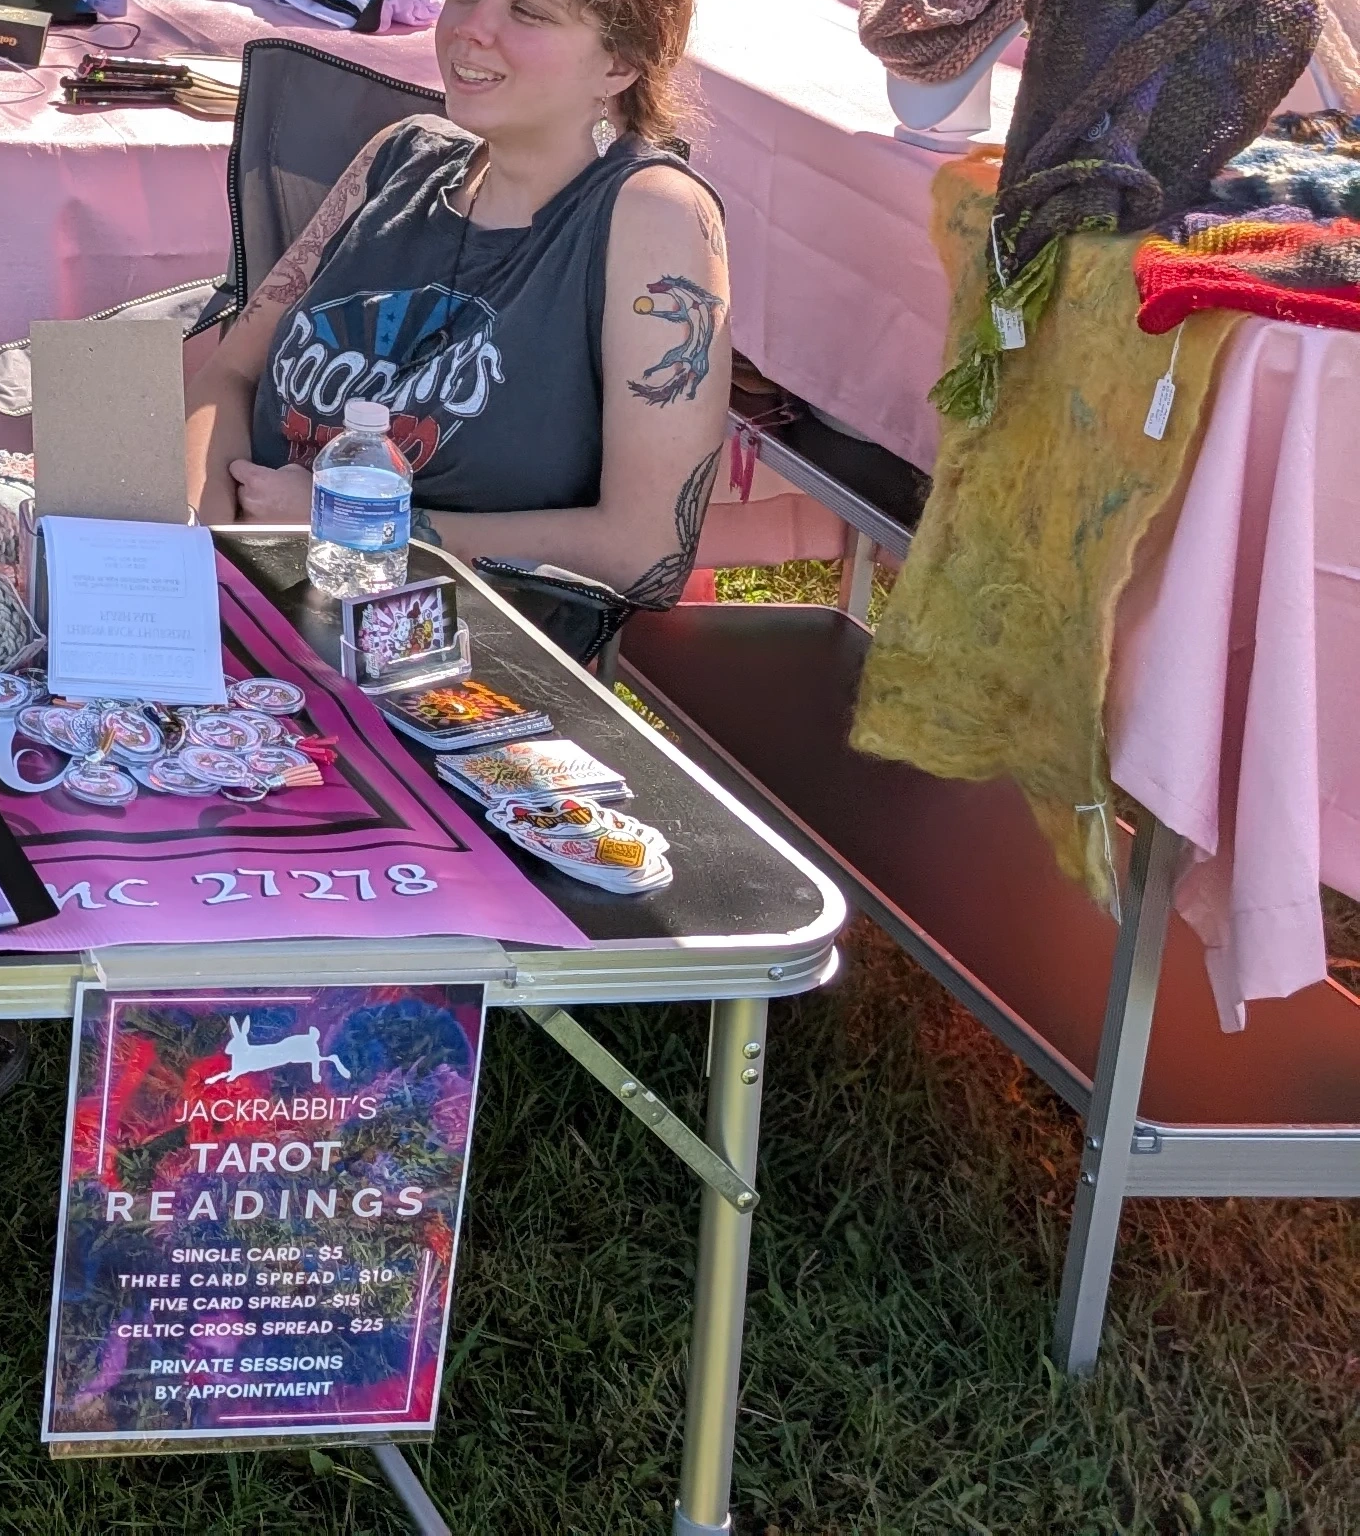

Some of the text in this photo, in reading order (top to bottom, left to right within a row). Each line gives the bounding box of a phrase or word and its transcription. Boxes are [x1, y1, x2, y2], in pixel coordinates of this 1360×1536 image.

[192, 863, 439, 906] 27278
[175, 1096, 378, 1123] JACKRABBIT'S
[190, 1141, 343, 1174] TAROT
[105, 1186, 425, 1222] READINGS
[171, 1248, 241, 1263] SINGLE
[246, 1247, 301, 1262] CARD
[318, 1245, 343, 1261] $5
[118, 1274, 181, 1288] THREE
[189, 1273, 247, 1287] CARD
[255, 1271, 335, 1286] SPREAD
[358, 1268, 393, 1284] $10
[150, 1297, 188, 1311] FIVE
[193, 1296, 244, 1310] CARD
[247, 1295, 317, 1309] SPREAD
[117, 1323, 185, 1338] CELTIC
[189, 1322, 257, 1337] CROSS
[261, 1320, 333, 1336] SPREAD
[349, 1317, 384, 1333] $25
[150, 1355, 343, 1375] PRIVATE SESSIONS
[154, 1381, 334, 1400] BY APPOINTMENT
